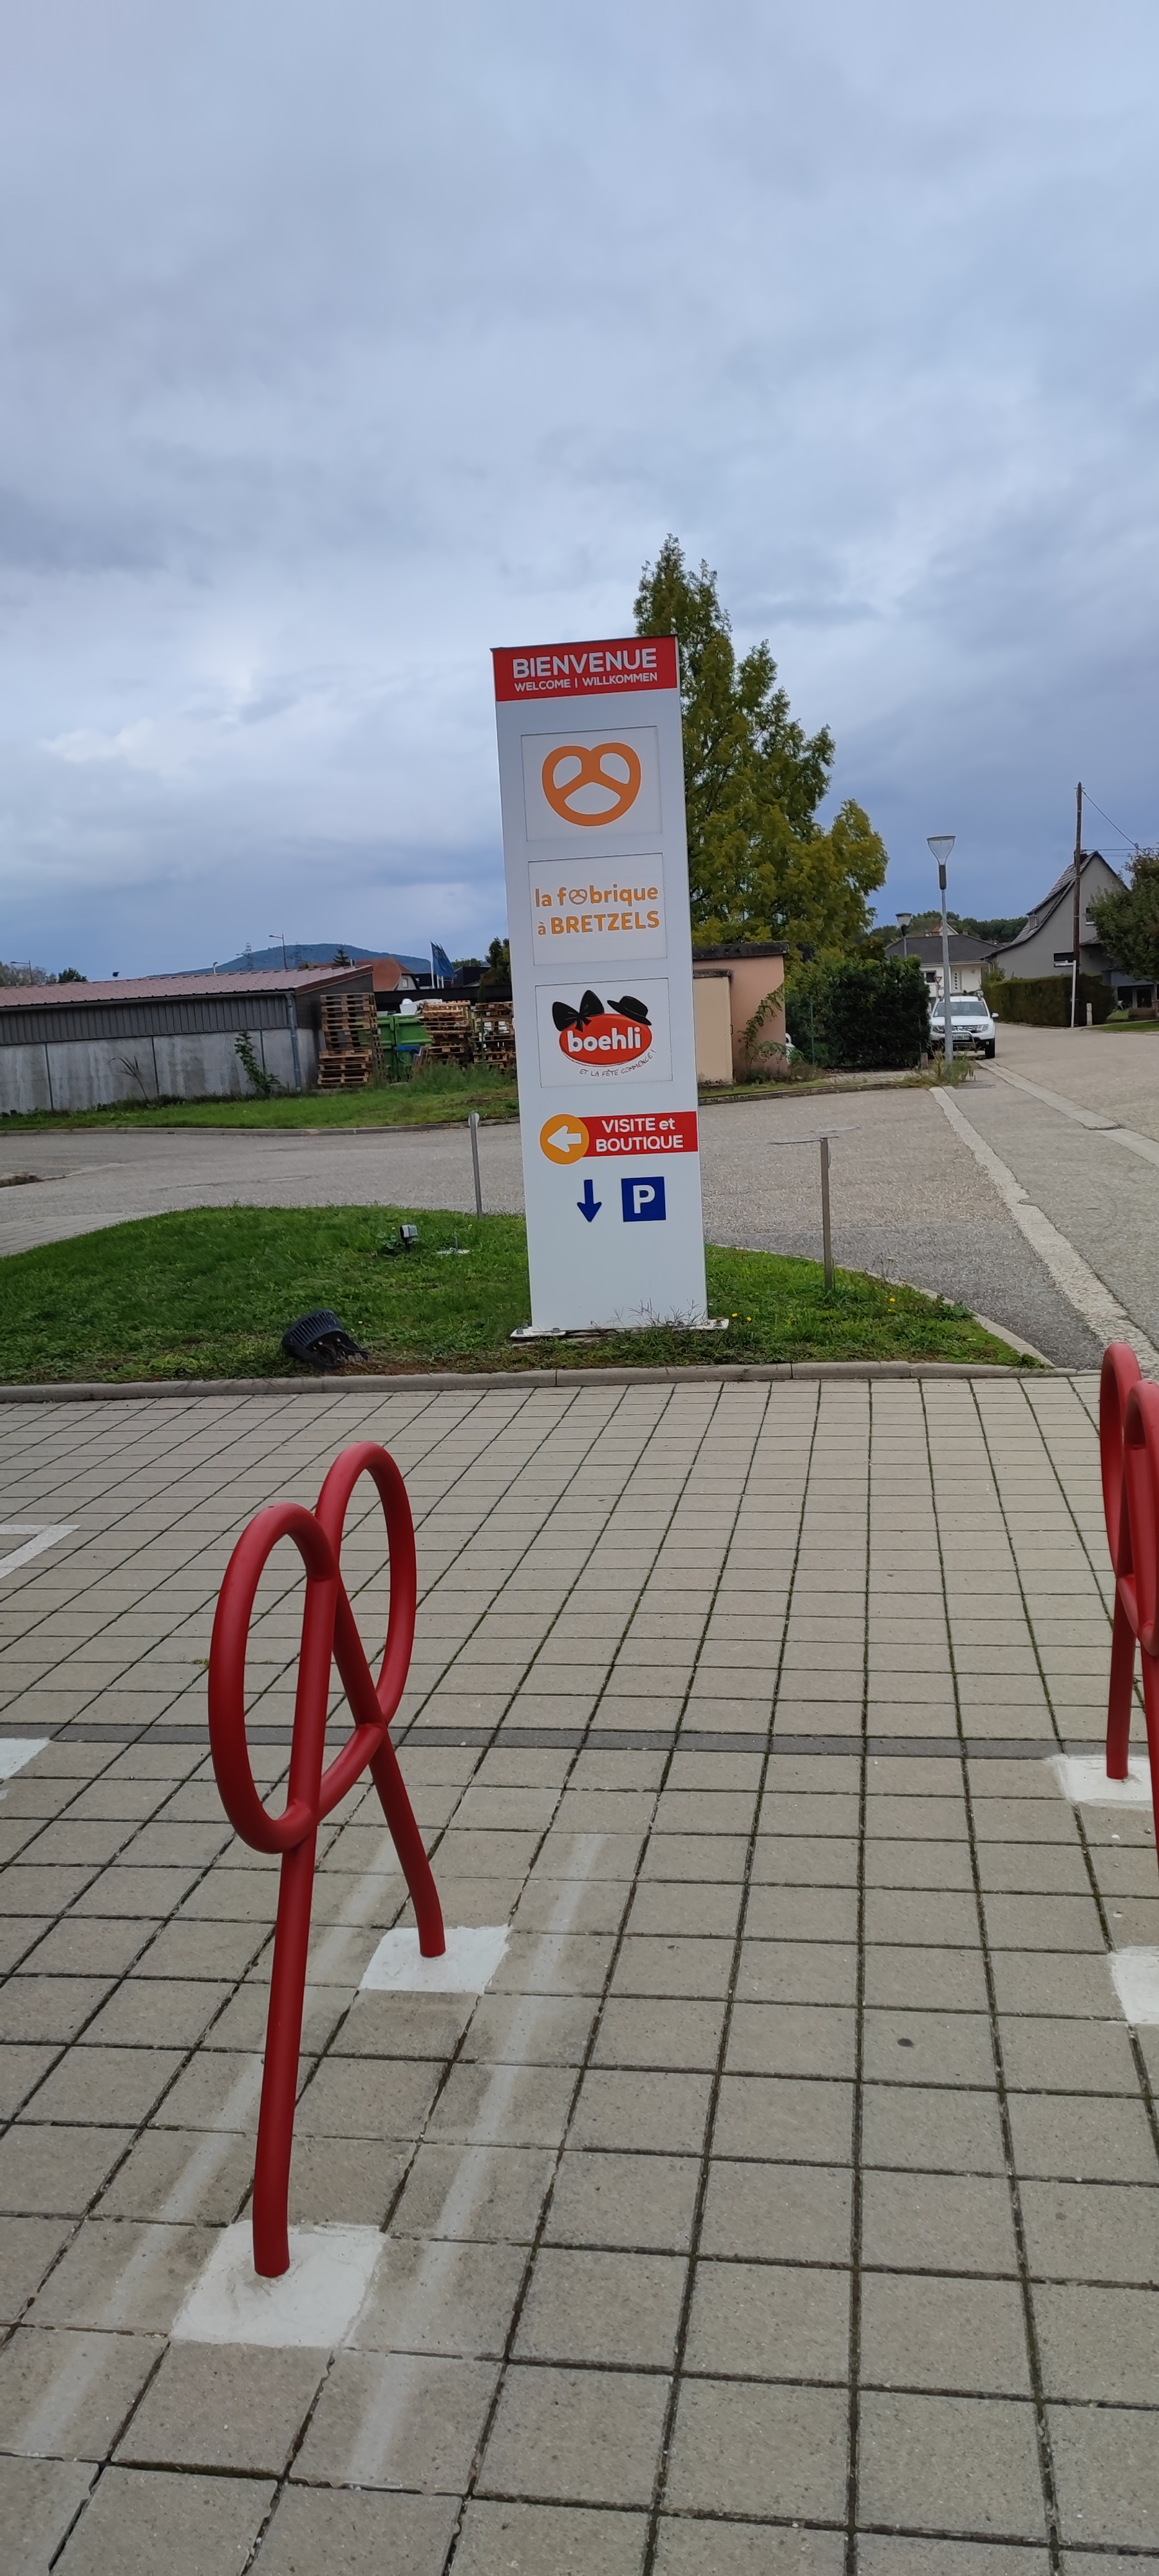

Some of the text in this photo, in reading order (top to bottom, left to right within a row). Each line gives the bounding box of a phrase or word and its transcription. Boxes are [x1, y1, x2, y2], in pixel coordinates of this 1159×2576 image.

[513, 647, 657, 679] BIENVENUE
[514, 678, 571, 692] WELCOME
[582, 672, 657, 687] WILLKOMMEN
[535, 888, 552, 907] la
[538, 911, 659, 936] à BRETZELS
[567, 1027, 641, 1053] boehli
[601, 1117, 675, 1133] VISITE et
[596, 1135, 684, 1152] BOUTIQUE
[632, 1184, 655, 1214] P
